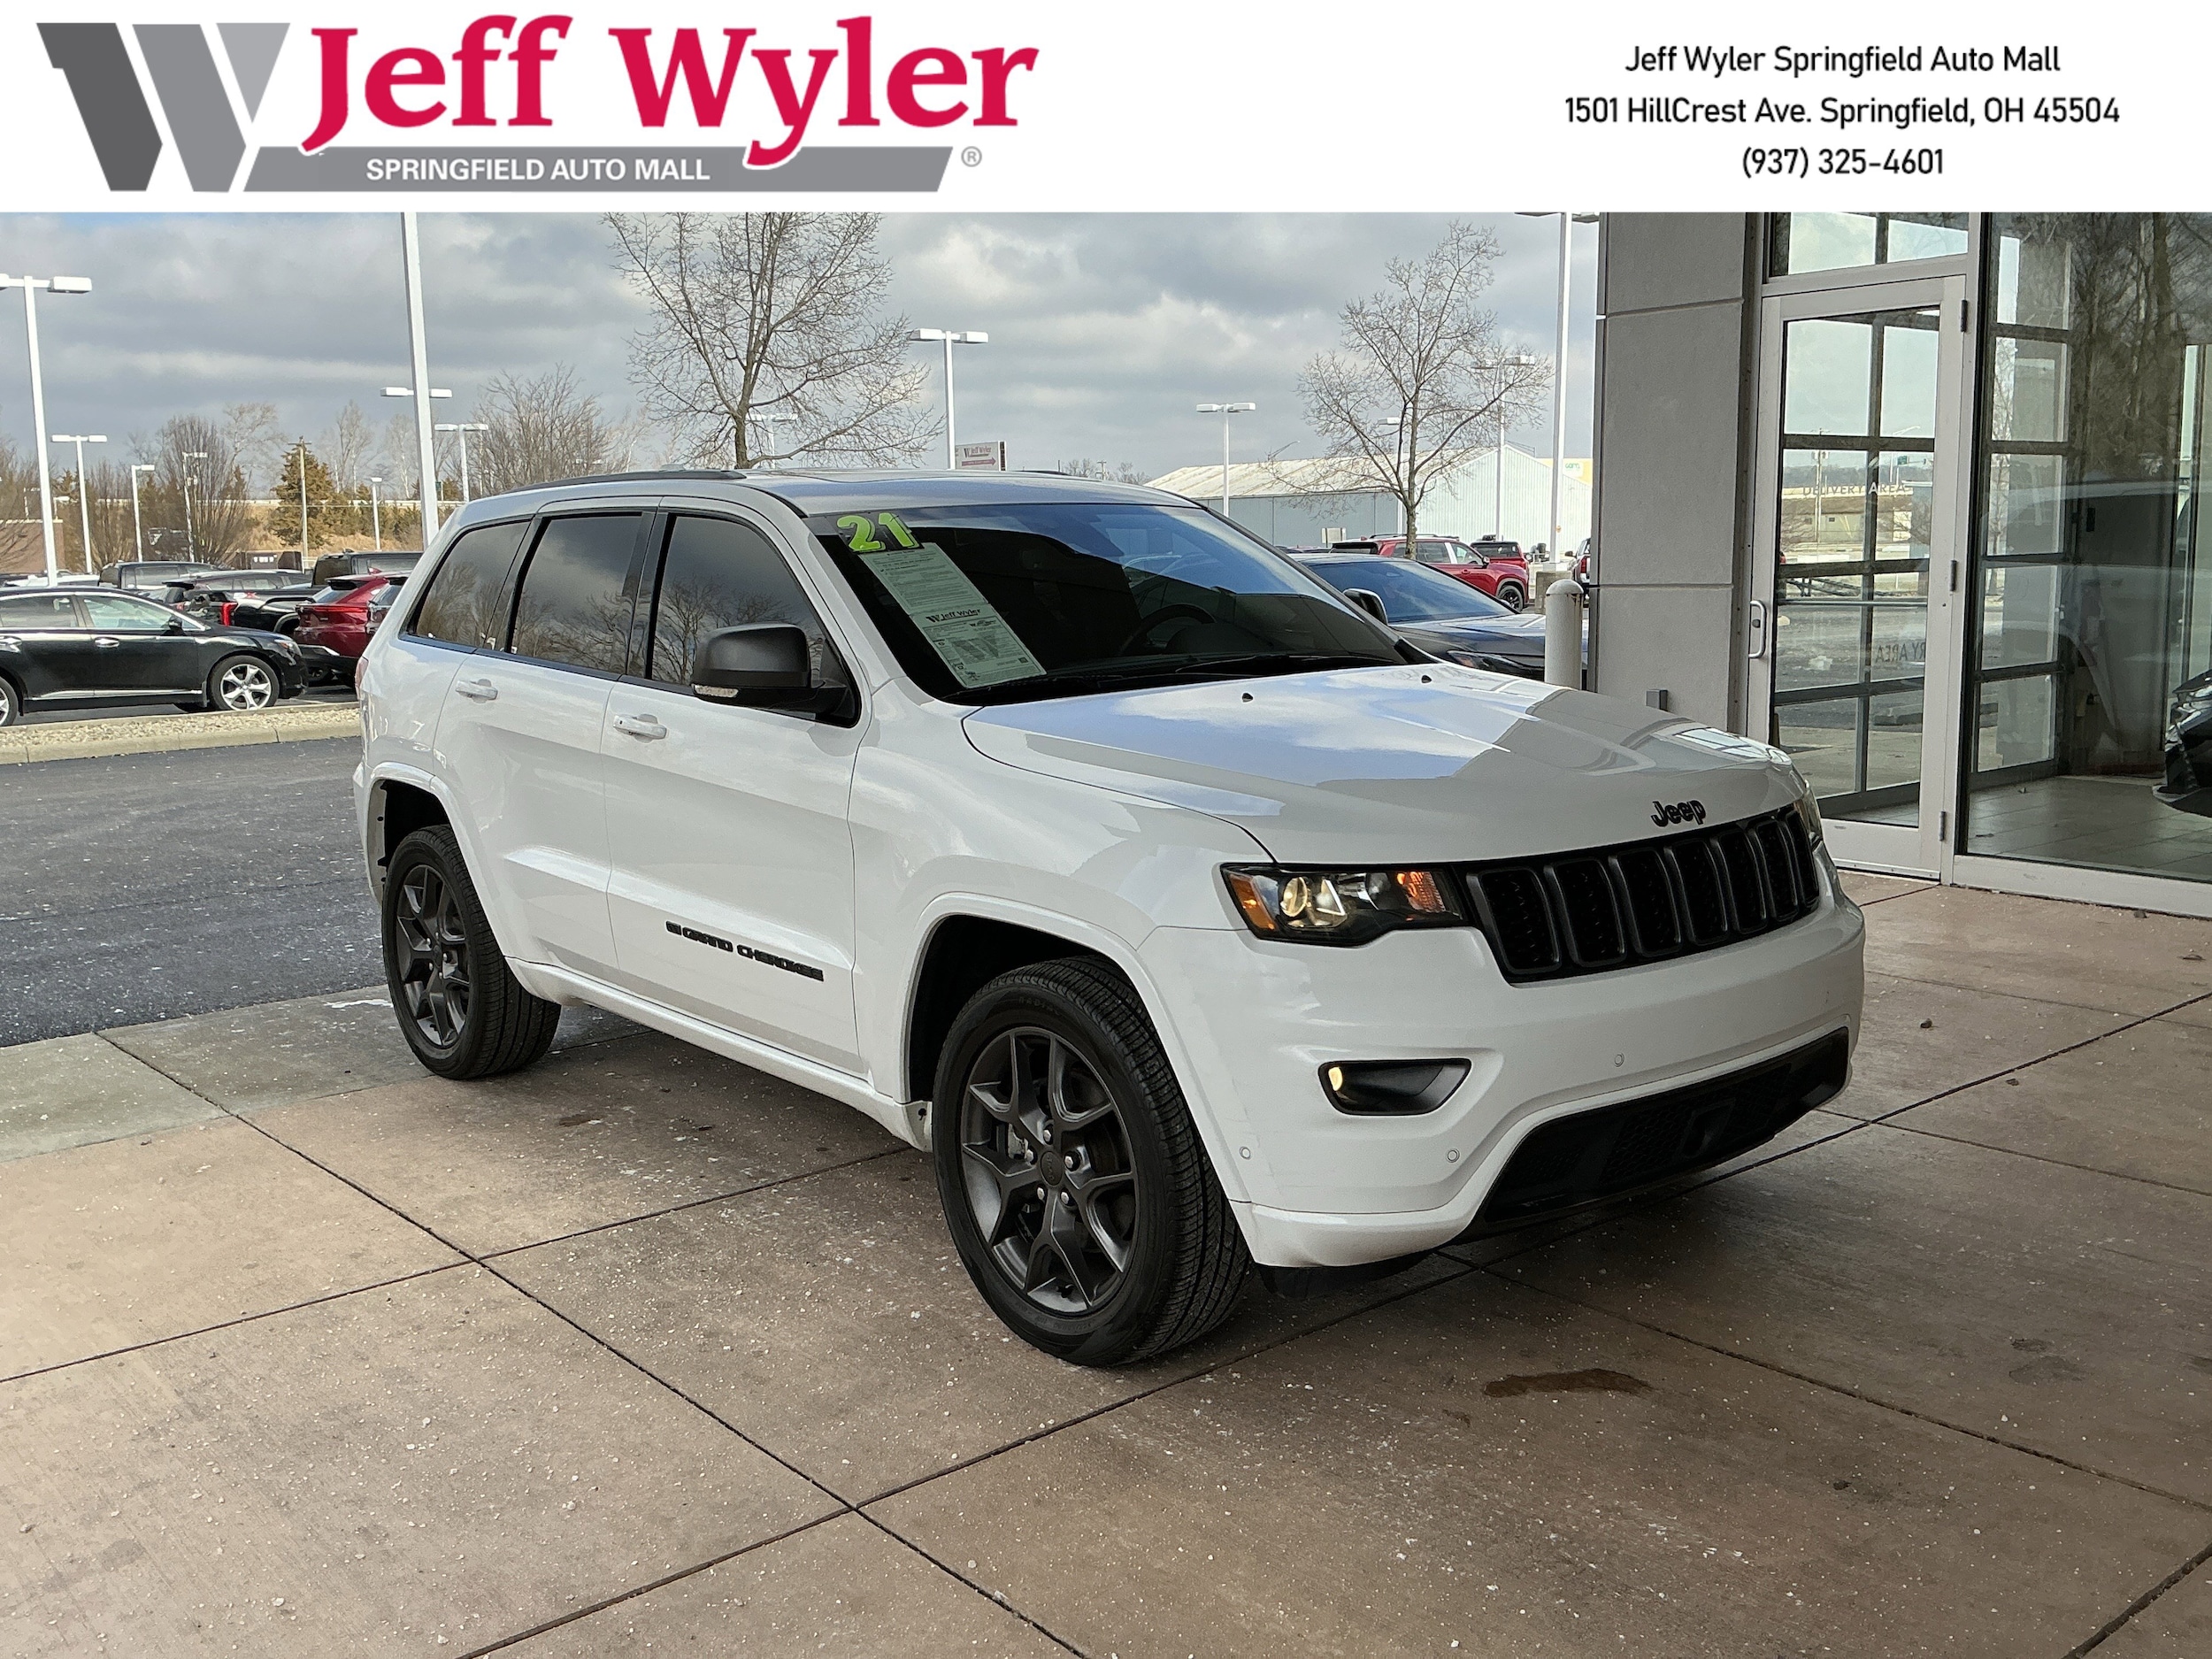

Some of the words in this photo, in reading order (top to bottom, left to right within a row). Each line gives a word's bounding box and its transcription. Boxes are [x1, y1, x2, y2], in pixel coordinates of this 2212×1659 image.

[1803, 486, 1863, 495] DELIVERY
[1869, 482, 1906, 495] AREA
[836, 512, 919, 552] 21
[940, 610, 956, 620] Jeff
[956, 608, 981, 618] Wyler
[1650, 800, 1706, 827] Jeep
[682, 926, 733, 952] GRAND
[737, 944, 824, 982] CHEROKEE
